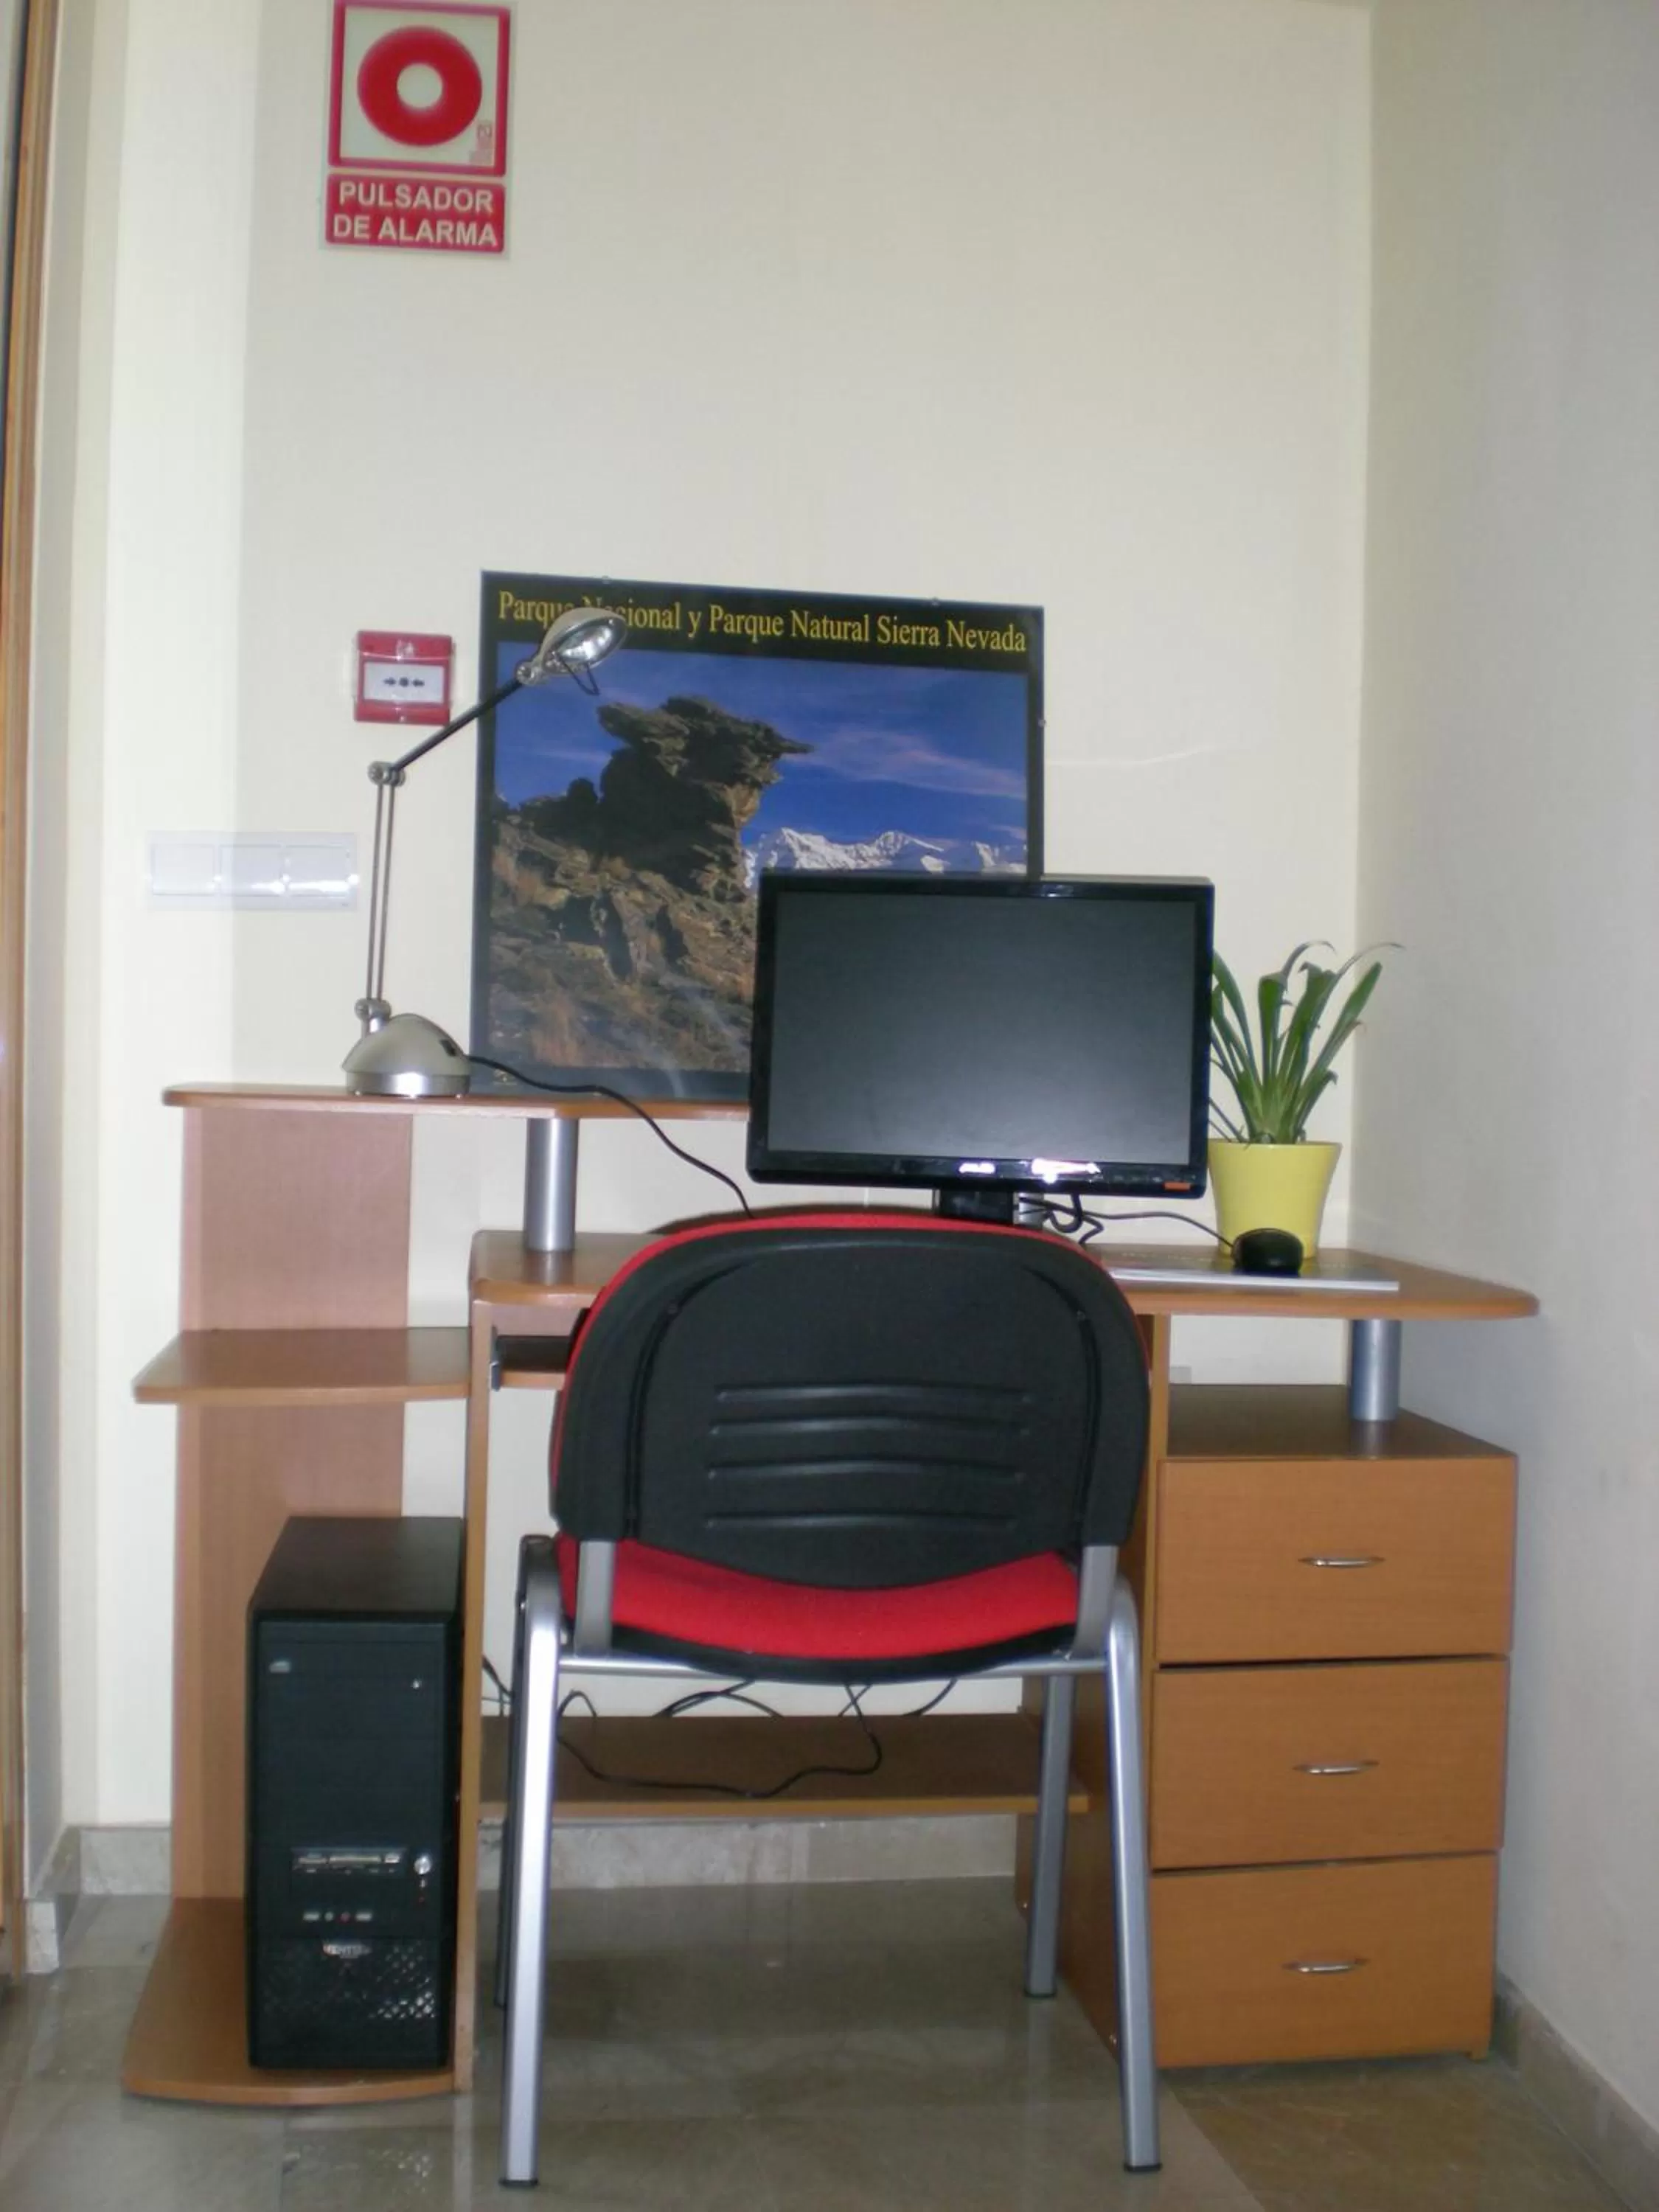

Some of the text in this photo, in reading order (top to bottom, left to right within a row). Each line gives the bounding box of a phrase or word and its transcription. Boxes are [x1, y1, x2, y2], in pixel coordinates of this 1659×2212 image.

[339, 181, 493, 213] PULSADOR
[333, 213, 498, 247] DE ALARMA
[687, 611, 702, 639] y
[709, 604, 785, 644] Parque
[790, 610, 870, 642] Natural
[877, 615, 940, 646] Sierra
[946, 619, 1026, 653] Nevada
